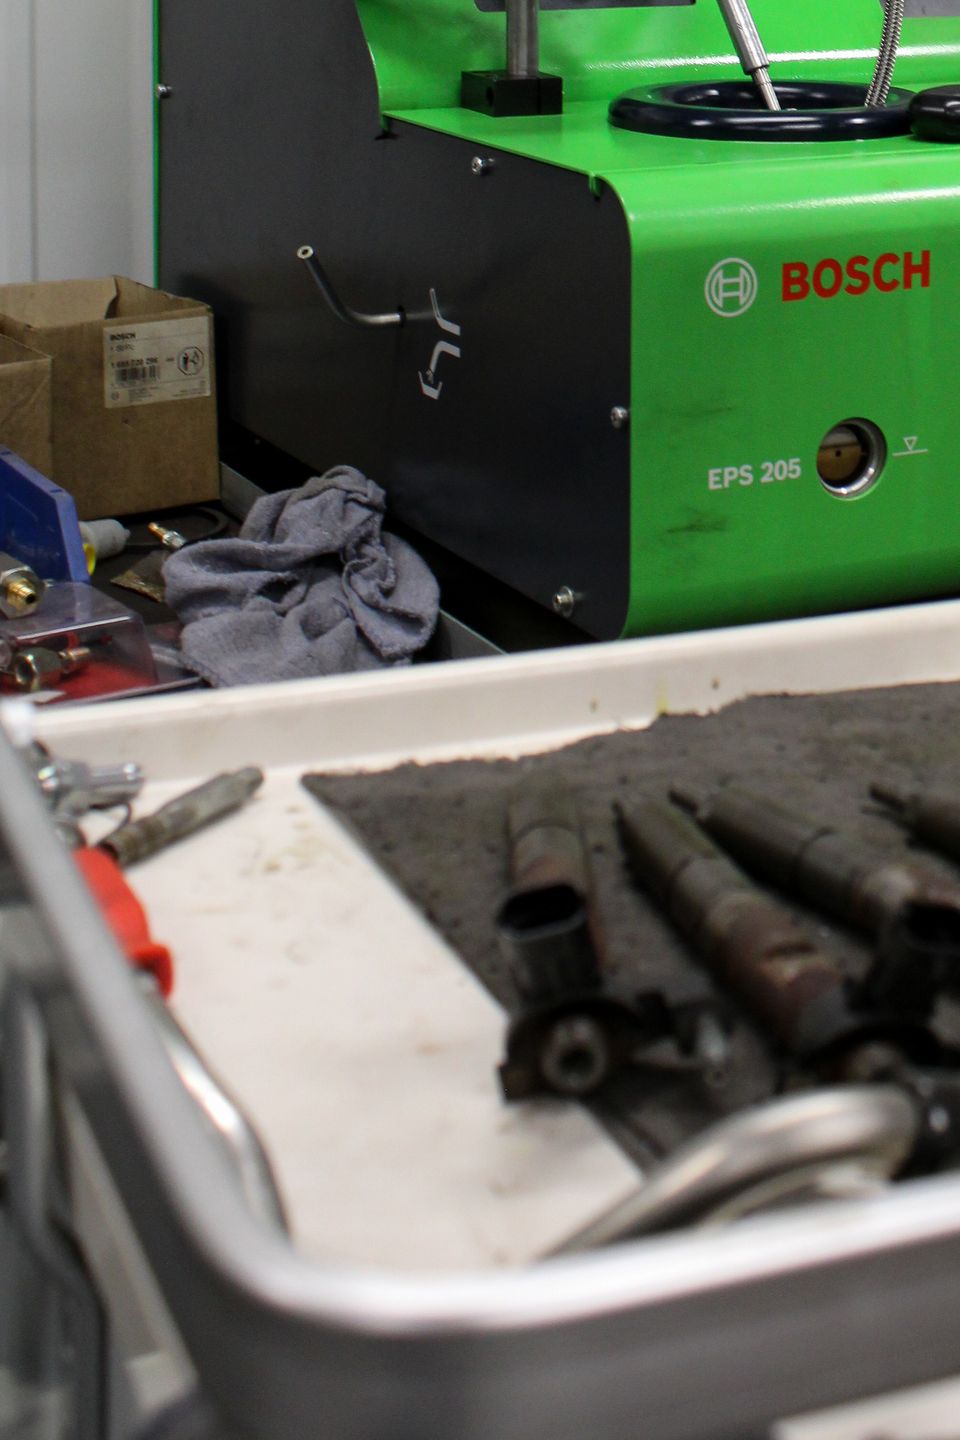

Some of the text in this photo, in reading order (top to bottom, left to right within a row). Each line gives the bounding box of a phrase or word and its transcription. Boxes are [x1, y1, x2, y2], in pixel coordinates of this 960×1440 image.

[782, 249, 931, 302] BOSCH
[708, 457, 802, 490] EPS 205
